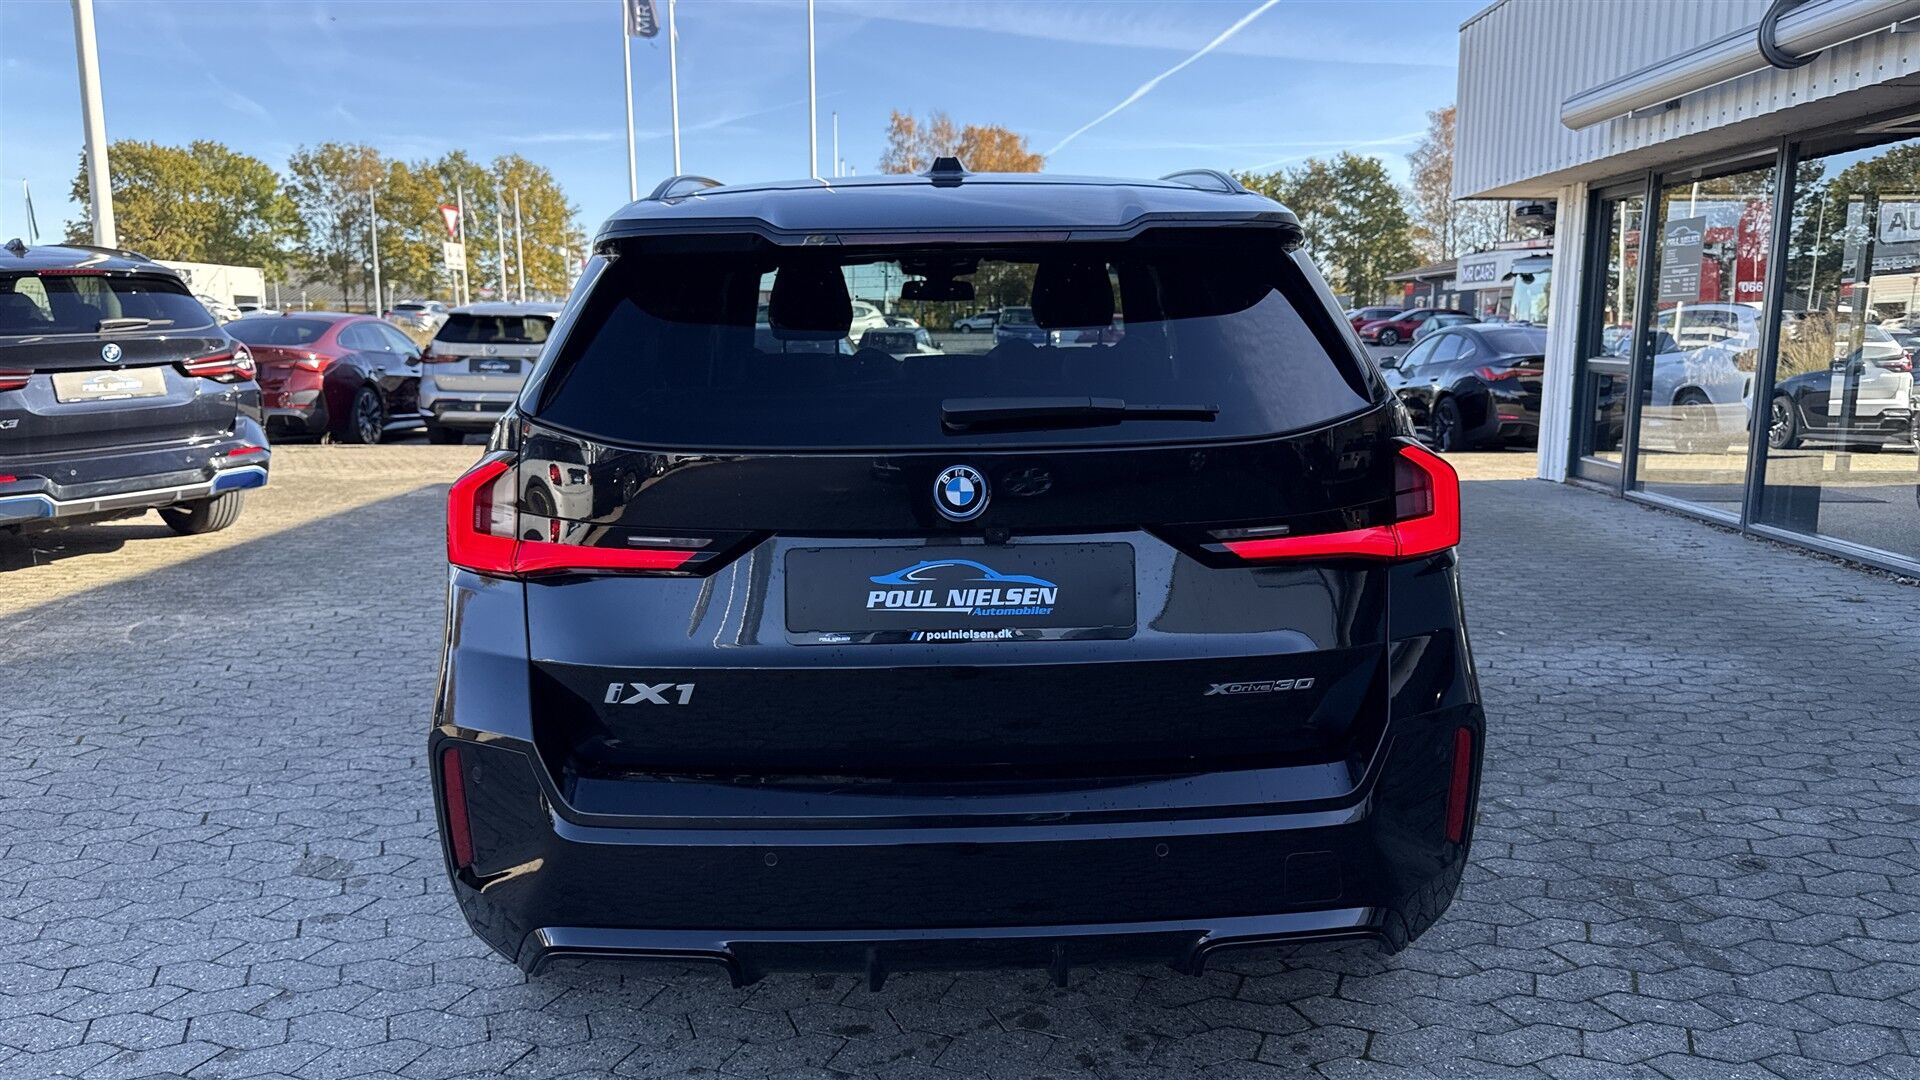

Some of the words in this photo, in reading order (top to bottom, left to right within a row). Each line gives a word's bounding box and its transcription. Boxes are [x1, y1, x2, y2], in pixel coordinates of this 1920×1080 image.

[1474, 263, 1495, 280] CARS
[866, 589, 937, 608] POUL
[946, 587, 1058, 607] NIELSEN
[972, 606, 1053, 616] Automobiler
[926, 628, 1013, 642] poulnielsen.dk
[604, 683, 695, 705] iX1
